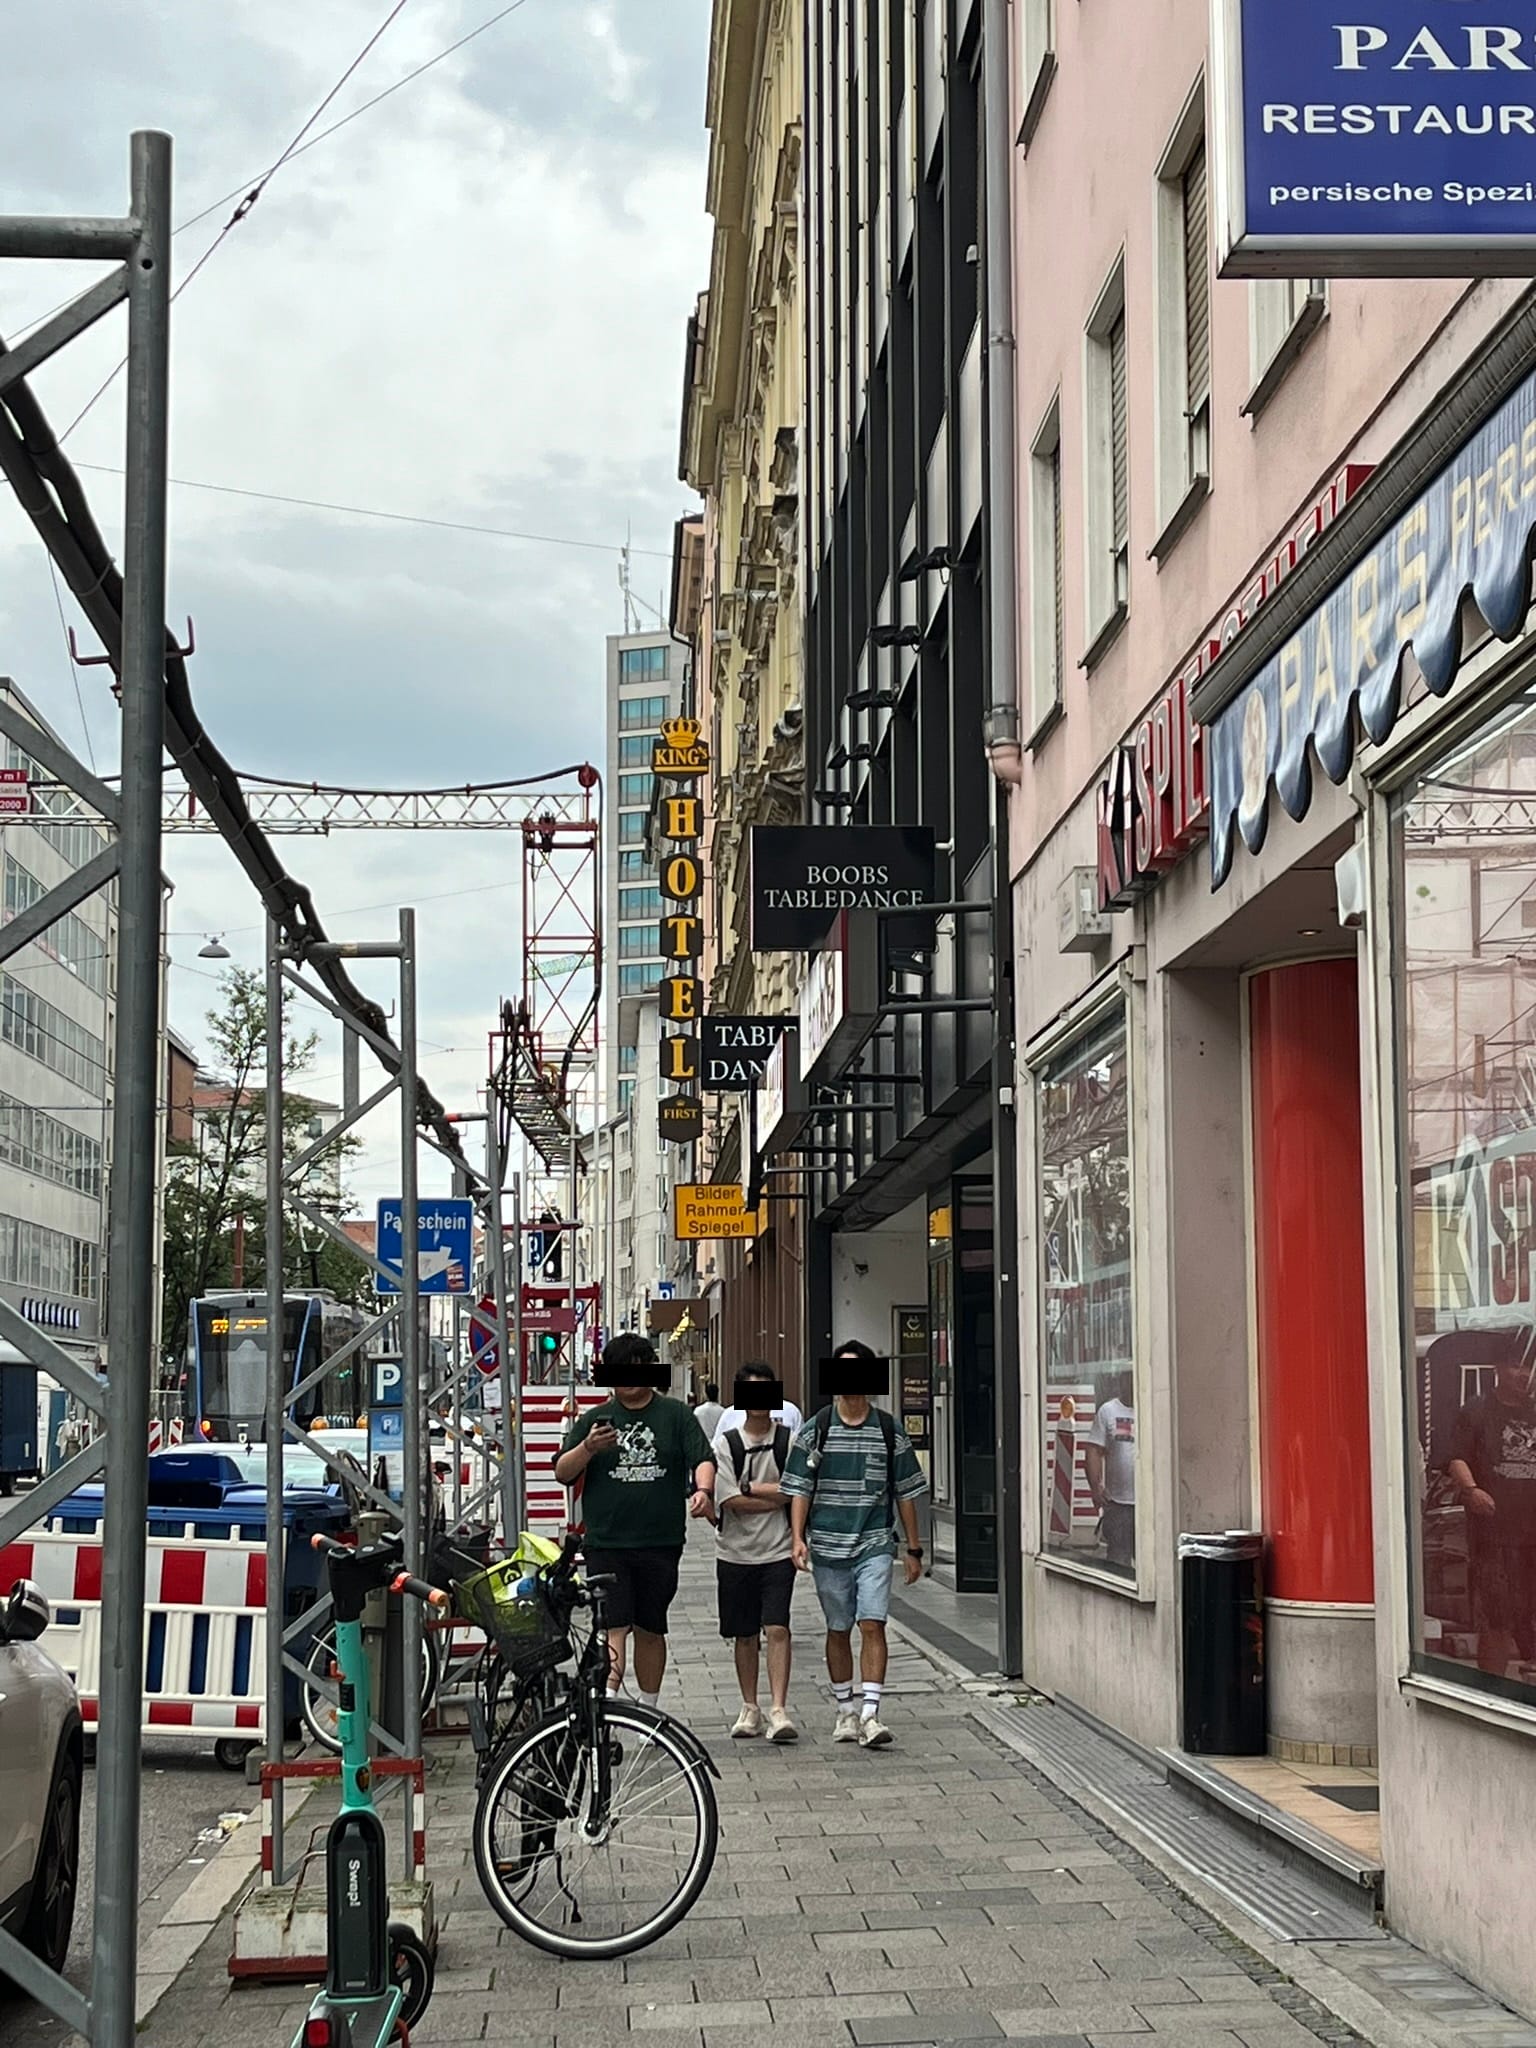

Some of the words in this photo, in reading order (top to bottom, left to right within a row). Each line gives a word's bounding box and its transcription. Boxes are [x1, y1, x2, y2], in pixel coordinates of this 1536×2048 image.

[1331, 25, 1536, 70] PAR
[1263, 104, 1536, 134] RESTAUR
[1270, 183, 1433, 206] persische
[1443, 182, 1536, 206] Spezi
[1280, 504, 1427, 752] PARS
[807, 865, 889, 885] BOOBS
[763, 889, 924, 909] TABLEDANCE
[663, 799, 698, 1077] HOTEL
[714, 1025, 798, 1047] TABL
[663, 1108, 698, 1120] FIRST
[695, 1187, 736, 1200] Bilder
[383, 1208, 467, 1233] Paschein
[688, 1220, 744, 1235] Spiegel
[376, 1363, 402, 1401] P
